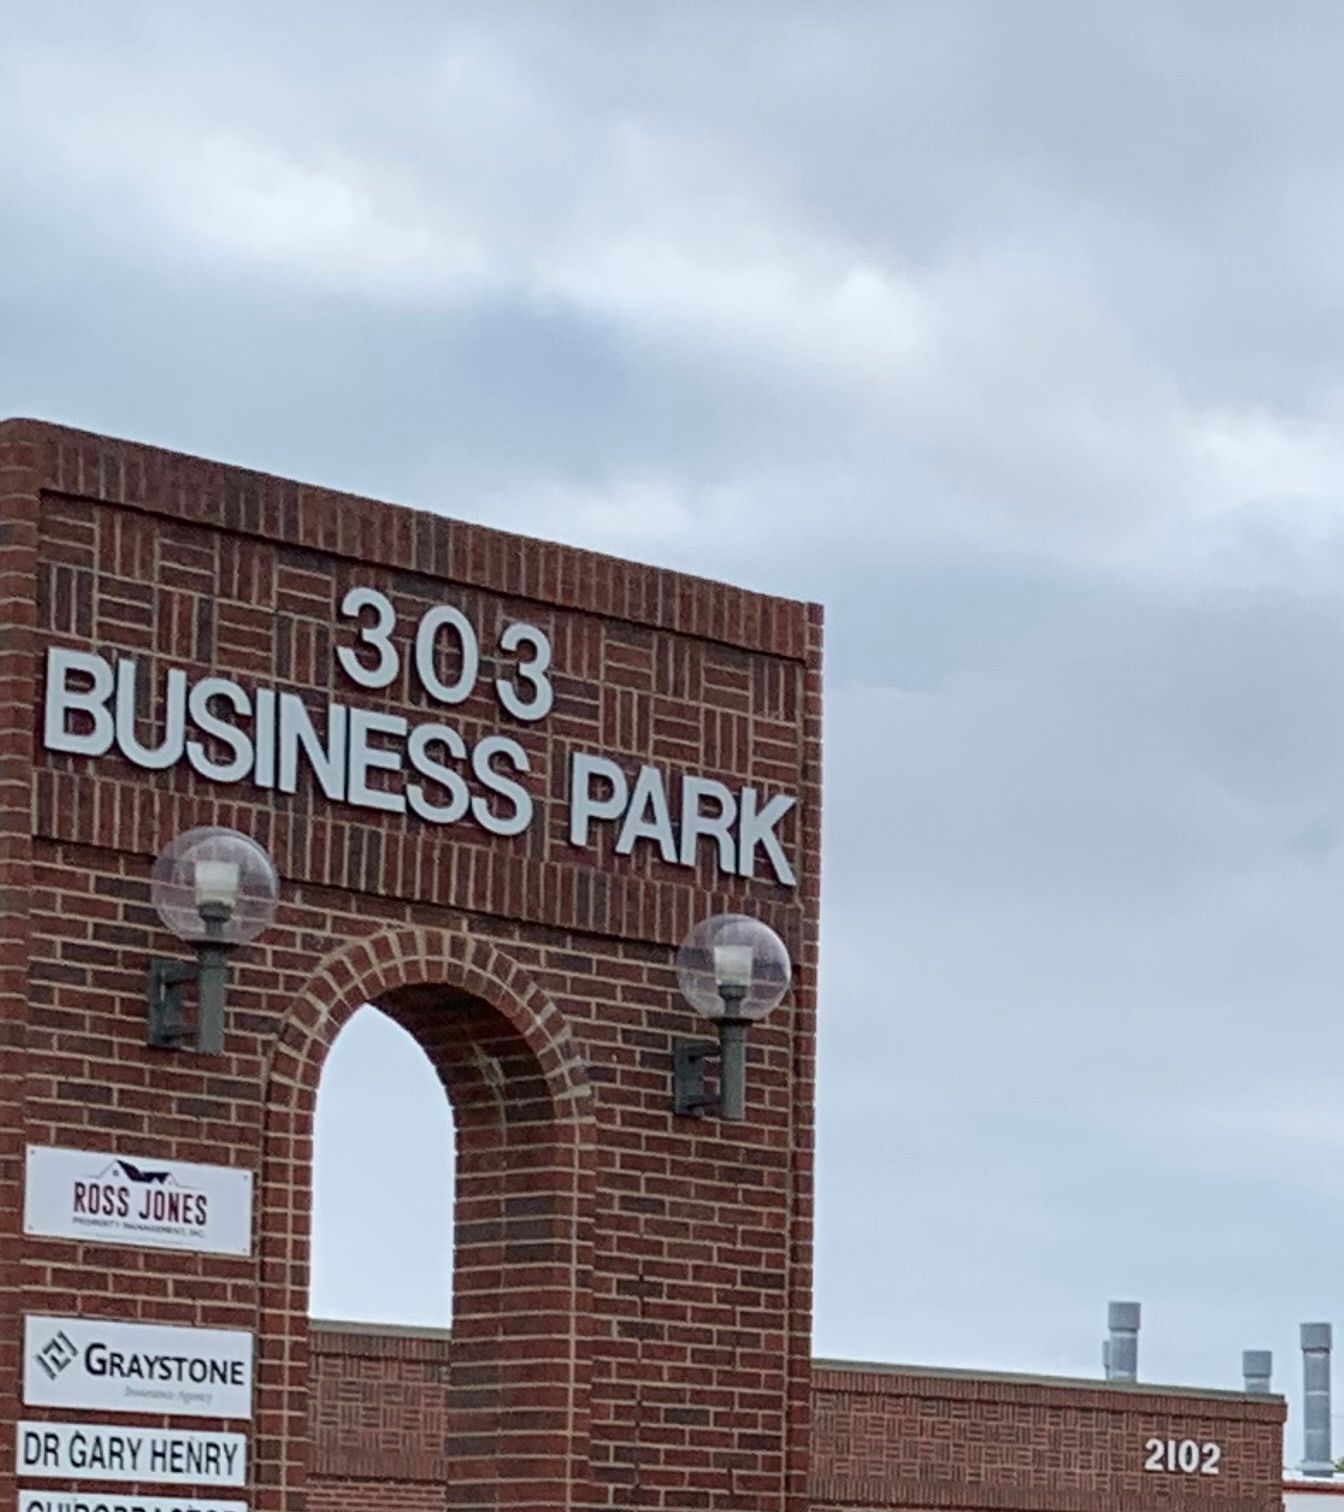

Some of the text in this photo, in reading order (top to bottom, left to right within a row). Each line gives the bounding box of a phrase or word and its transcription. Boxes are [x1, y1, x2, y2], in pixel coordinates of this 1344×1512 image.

[337, 587, 554, 722] 303
[43, 646, 797, 886] BUSINESS PARK
[73, 1181, 207, 1226] ROSS JONES
[84, 1342, 245, 1386] GRAYSTONE
[24, 1431, 238, 1476] DR GARY HENRY
[1144, 1437, 1221, 1475] 2102
